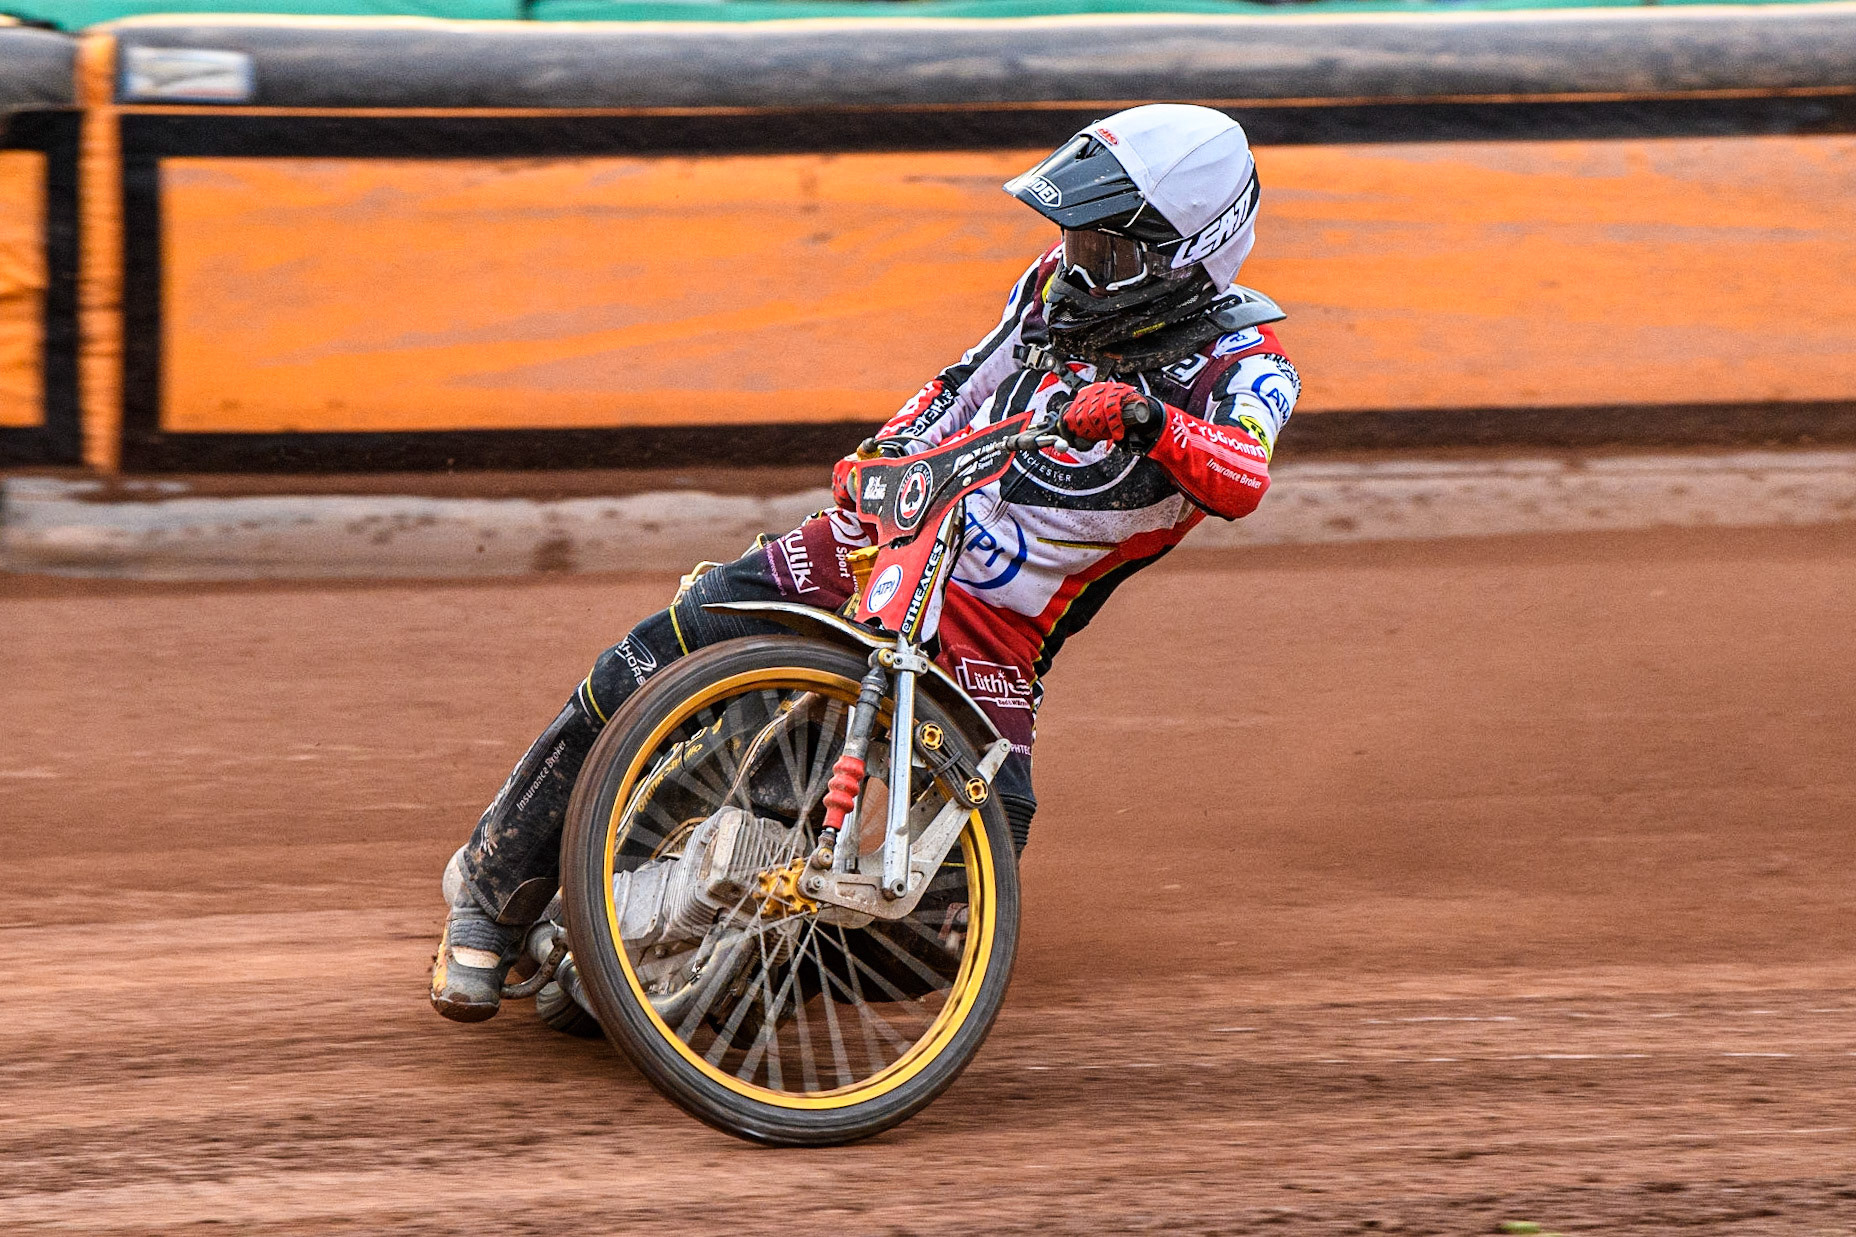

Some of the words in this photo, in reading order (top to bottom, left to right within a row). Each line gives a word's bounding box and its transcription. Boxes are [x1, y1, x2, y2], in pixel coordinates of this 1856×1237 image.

[1029, 177, 1058, 203] OEI
[1020, 450, 1072, 482] NCHESTER
[1206, 458, 1242, 482] Insurance
[1239, 473, 1262, 489] Broker
[835, 546, 851, 578] Sport
[873, 579, 896, 597] ATPI
[515, 766, 549, 812] Insurance
[544, 740, 567, 769] Broker
